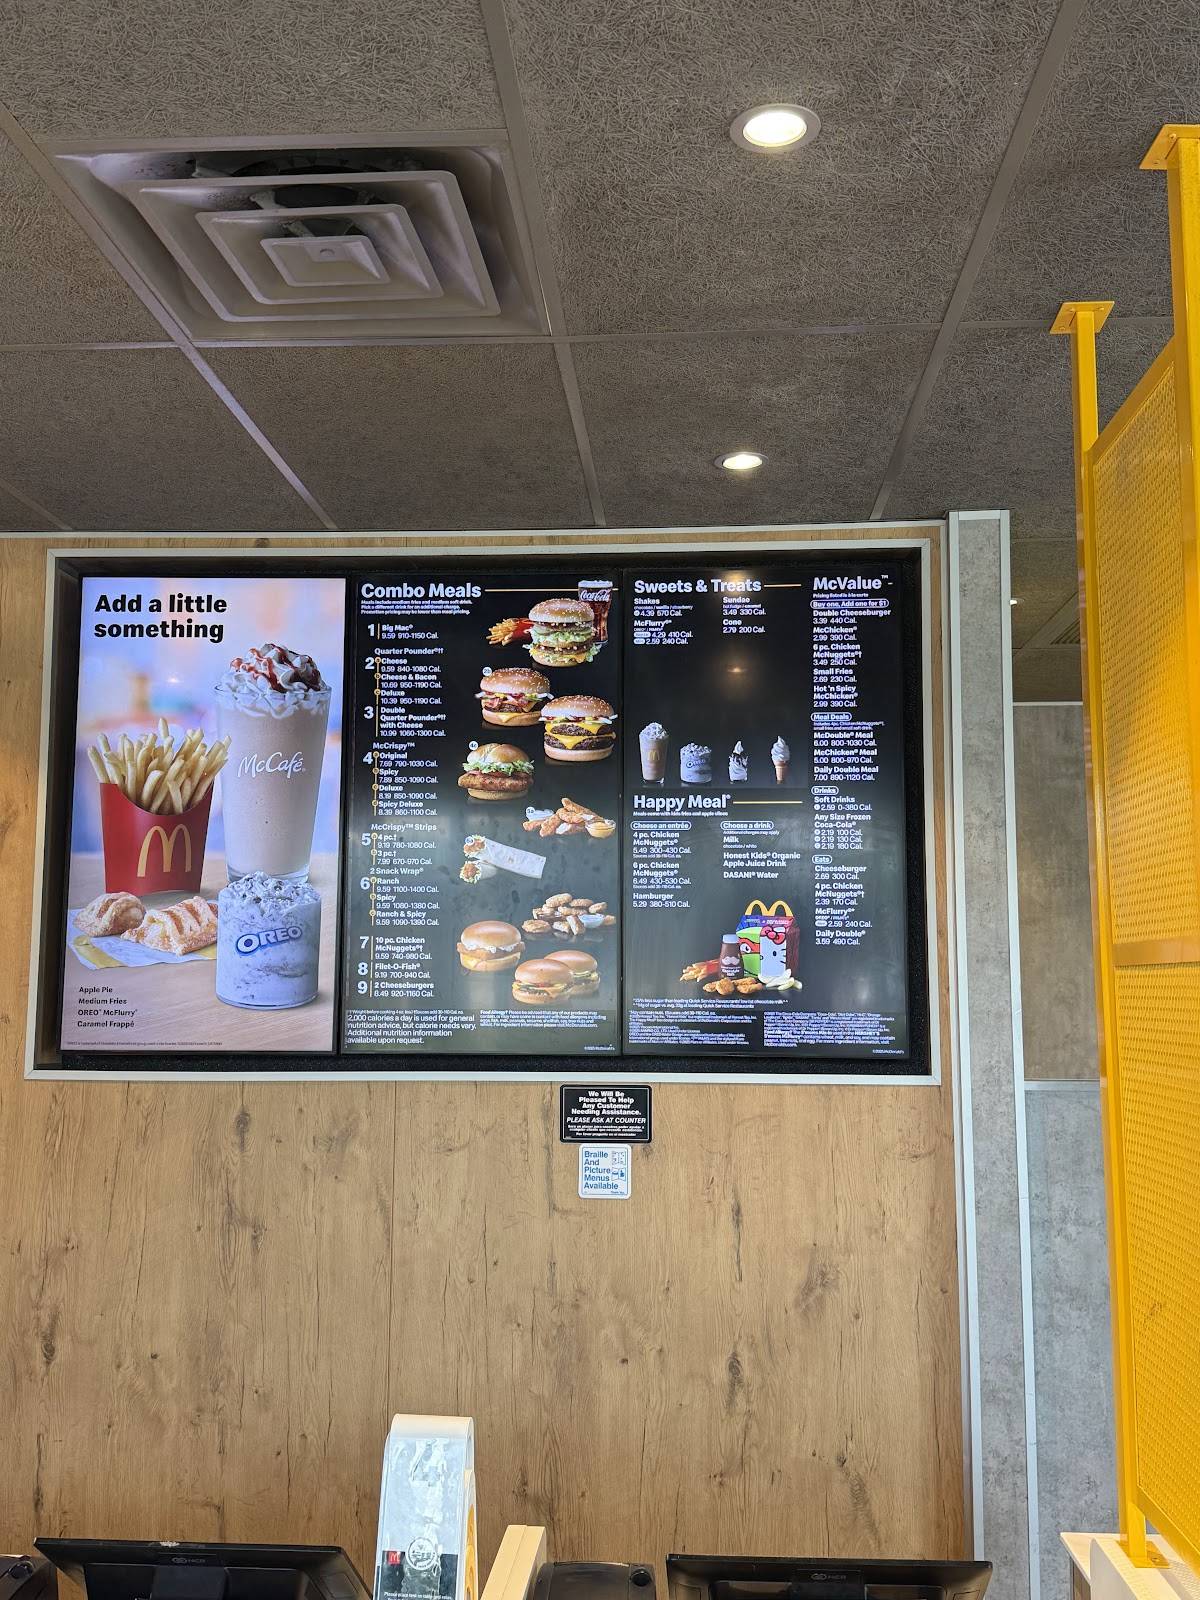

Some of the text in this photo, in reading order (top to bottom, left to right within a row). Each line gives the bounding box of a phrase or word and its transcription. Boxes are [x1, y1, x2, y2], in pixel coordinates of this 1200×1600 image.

[361, 583, 481, 598] Combo Meals
[634, 579, 761, 593] Sweets & Treats
[95, 593, 227, 612] Add a little
[94, 619, 224, 643] something
[368, 624, 374, 636] 1
[365, 657, 374, 669] 2
[364, 706, 374, 719] 3
[363, 752, 373, 764] 4
[814, 766, 832, 774] Daily
[633, 795, 685, 812] Happy
[362, 833, 370, 845] 5
[815, 865, 866, 873] Cheeseburger
[360, 878, 370, 890] 6
[633, 893, 674, 901] Hamburger
[236, 925, 302, 955] OREO
[360, 936, 368, 948] 7
[358, 962, 368, 975] 8
[358, 981, 368, 994] 9
[380, 982, 434, 990] Cheeseburgers
[109, 1020, 134, 1029] Frappé
